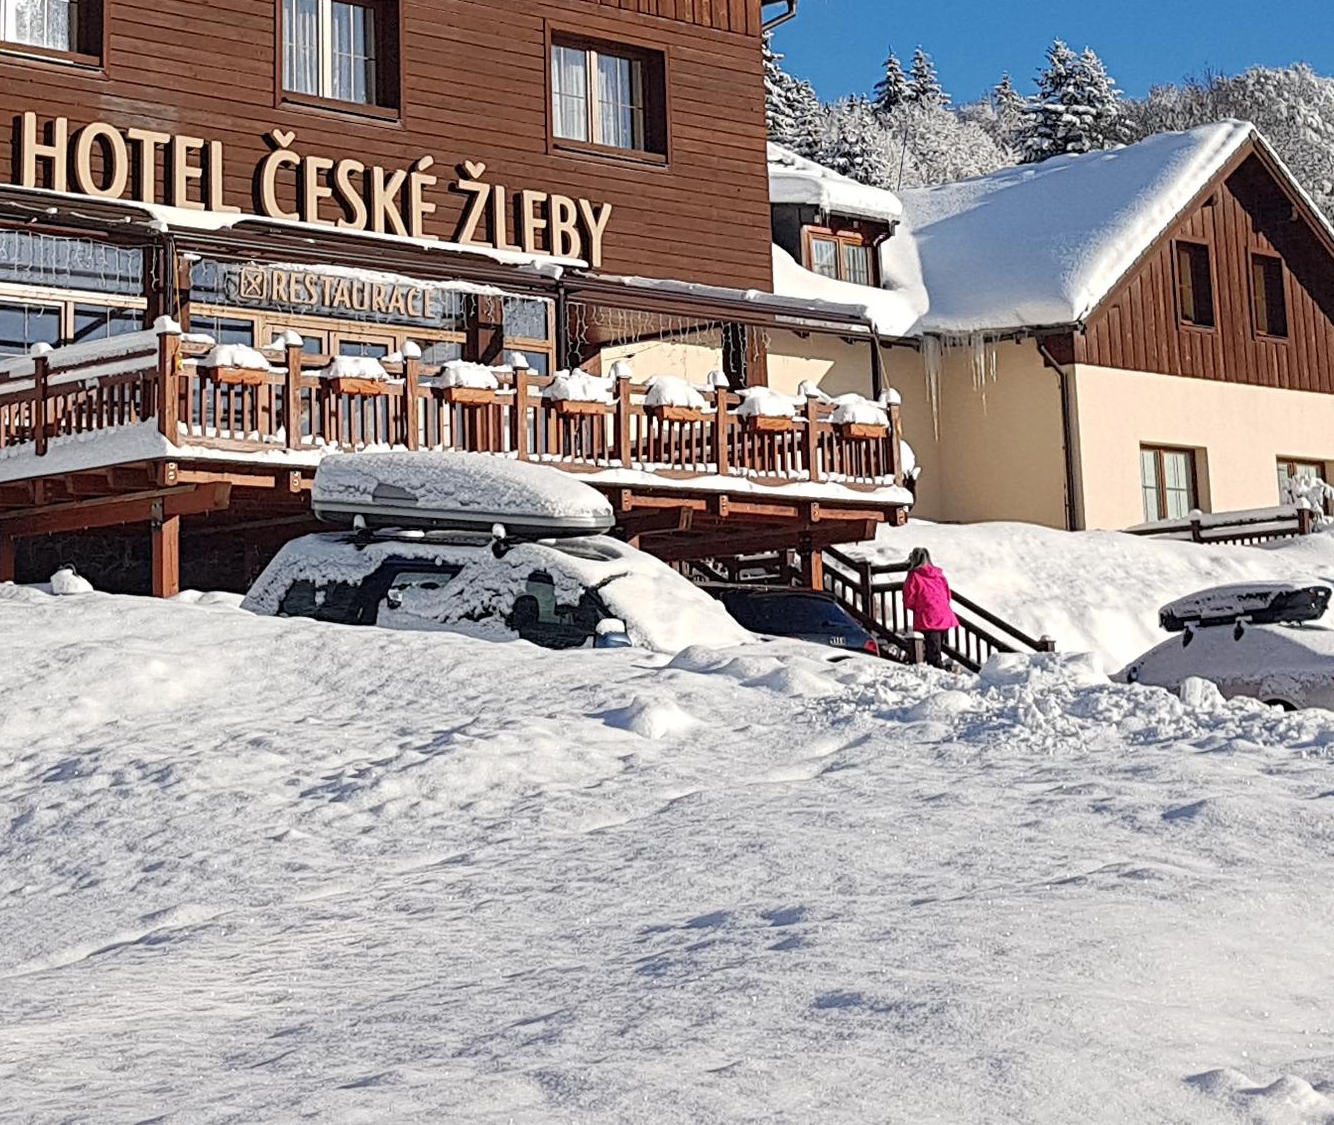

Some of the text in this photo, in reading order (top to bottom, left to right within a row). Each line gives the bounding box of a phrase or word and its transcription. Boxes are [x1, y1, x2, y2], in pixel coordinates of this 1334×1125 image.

[22, 111, 612, 268] HOTEL ČESKÉ ŽLEBY
[271, 270, 436, 318] RESTAURACE
